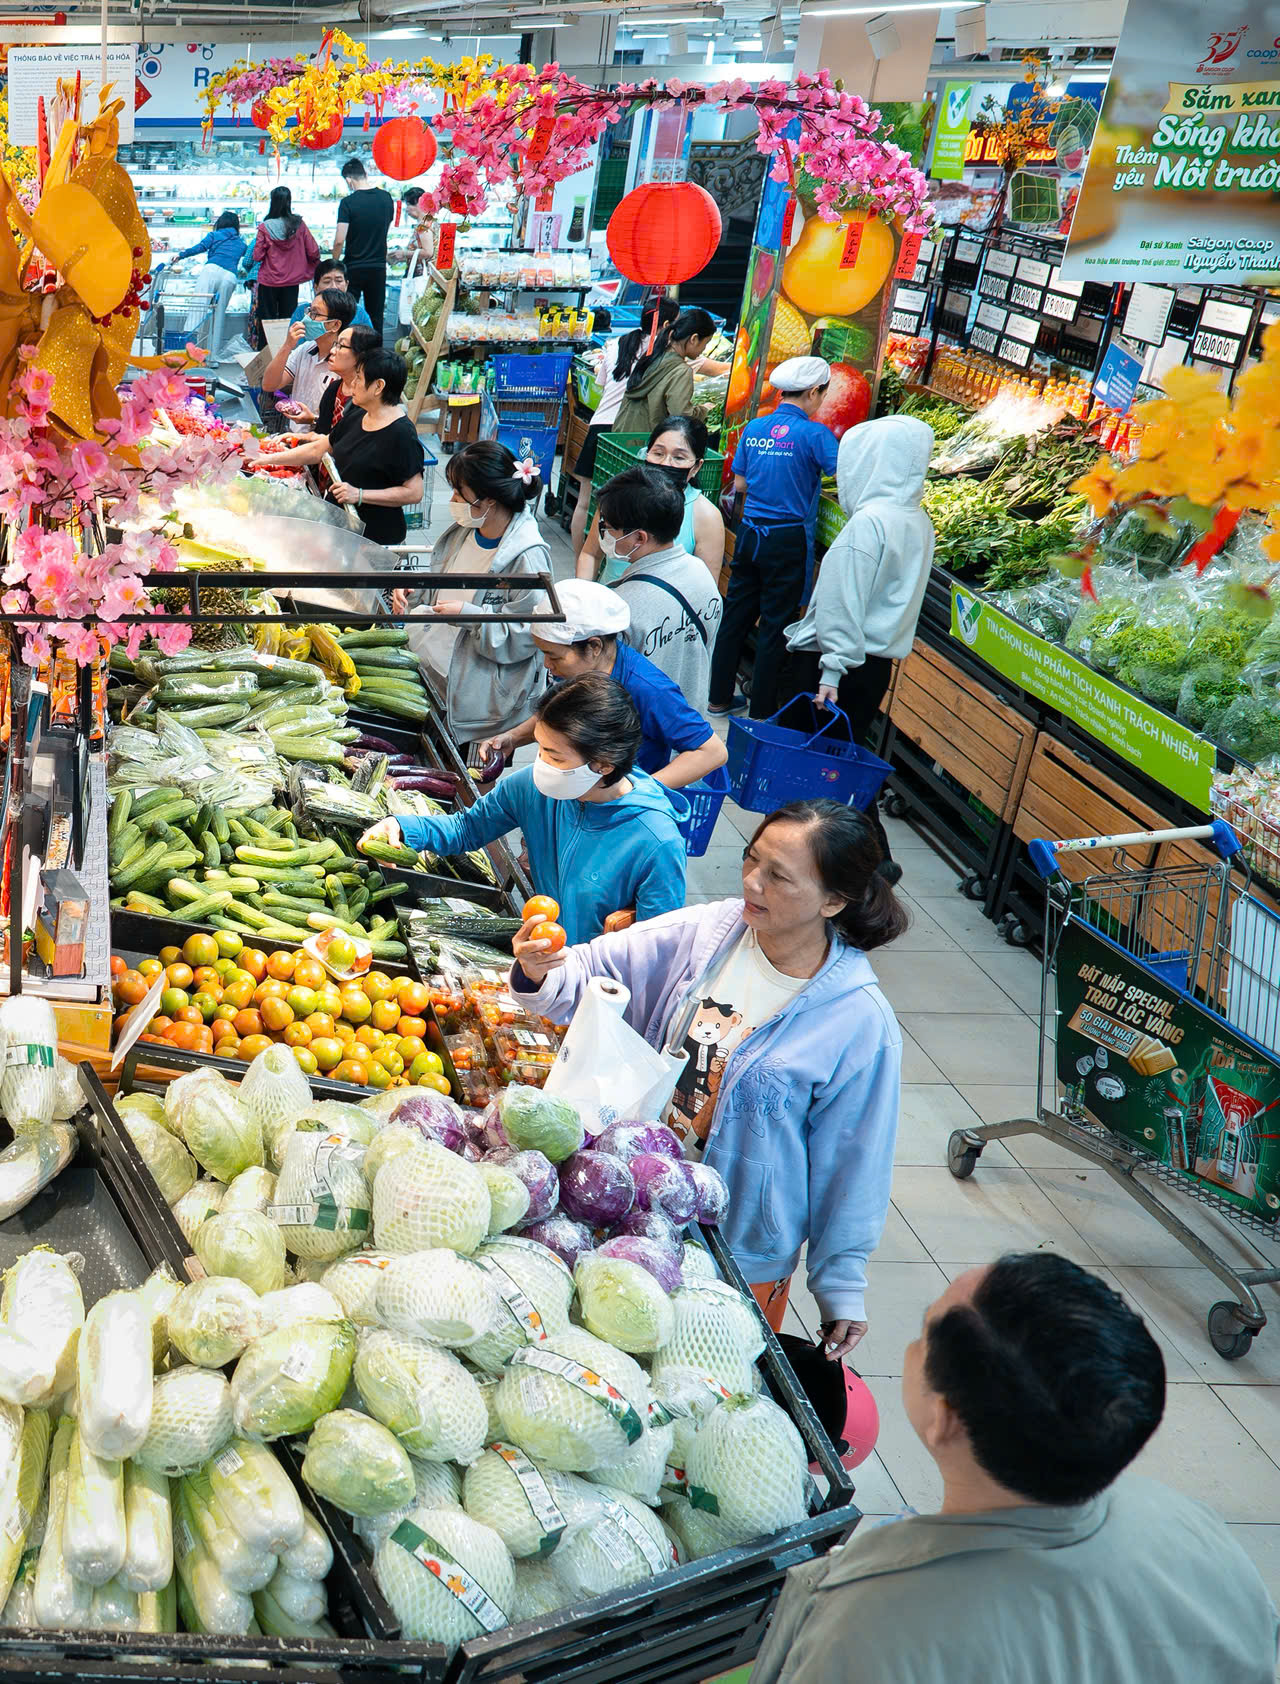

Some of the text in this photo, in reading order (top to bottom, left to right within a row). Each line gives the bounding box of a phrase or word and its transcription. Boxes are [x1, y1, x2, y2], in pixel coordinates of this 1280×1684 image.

[96, 53, 114, 61] HNG
[1182, 84, 1236, 110] Sắm
[1152, 112, 1227, 156] Sống
[1115, 145, 1159, 165] Thêm
[1112, 167, 1145, 191] yêu
[1153, 155, 1280, 188] Môi trườ
[1164, 241, 1183, 249] Xanh
[1186, 236, 1275, 252] Saigon Co.op
[1183, 252, 1236, 274] Nguyễn
[644, 616, 673, 657] The
[1023, 643, 1041, 665] SẢN
[1043, 655, 1071, 681] PHẨM
[1072, 671, 1092, 697] TÍCH
[1094, 686, 1121, 717] XANH
[1124, 706, 1159, 741] TRÁCH
[1161, 730, 1199, 767] NHIỆM
[1077, 962, 1175, 1021] BẬT NẮP SPECIAL
[1080, 1008, 1138, 1046] 50 GIẢI NHẤT
[1084, 985, 1185, 1045] TRAO LỘC VÀNG
